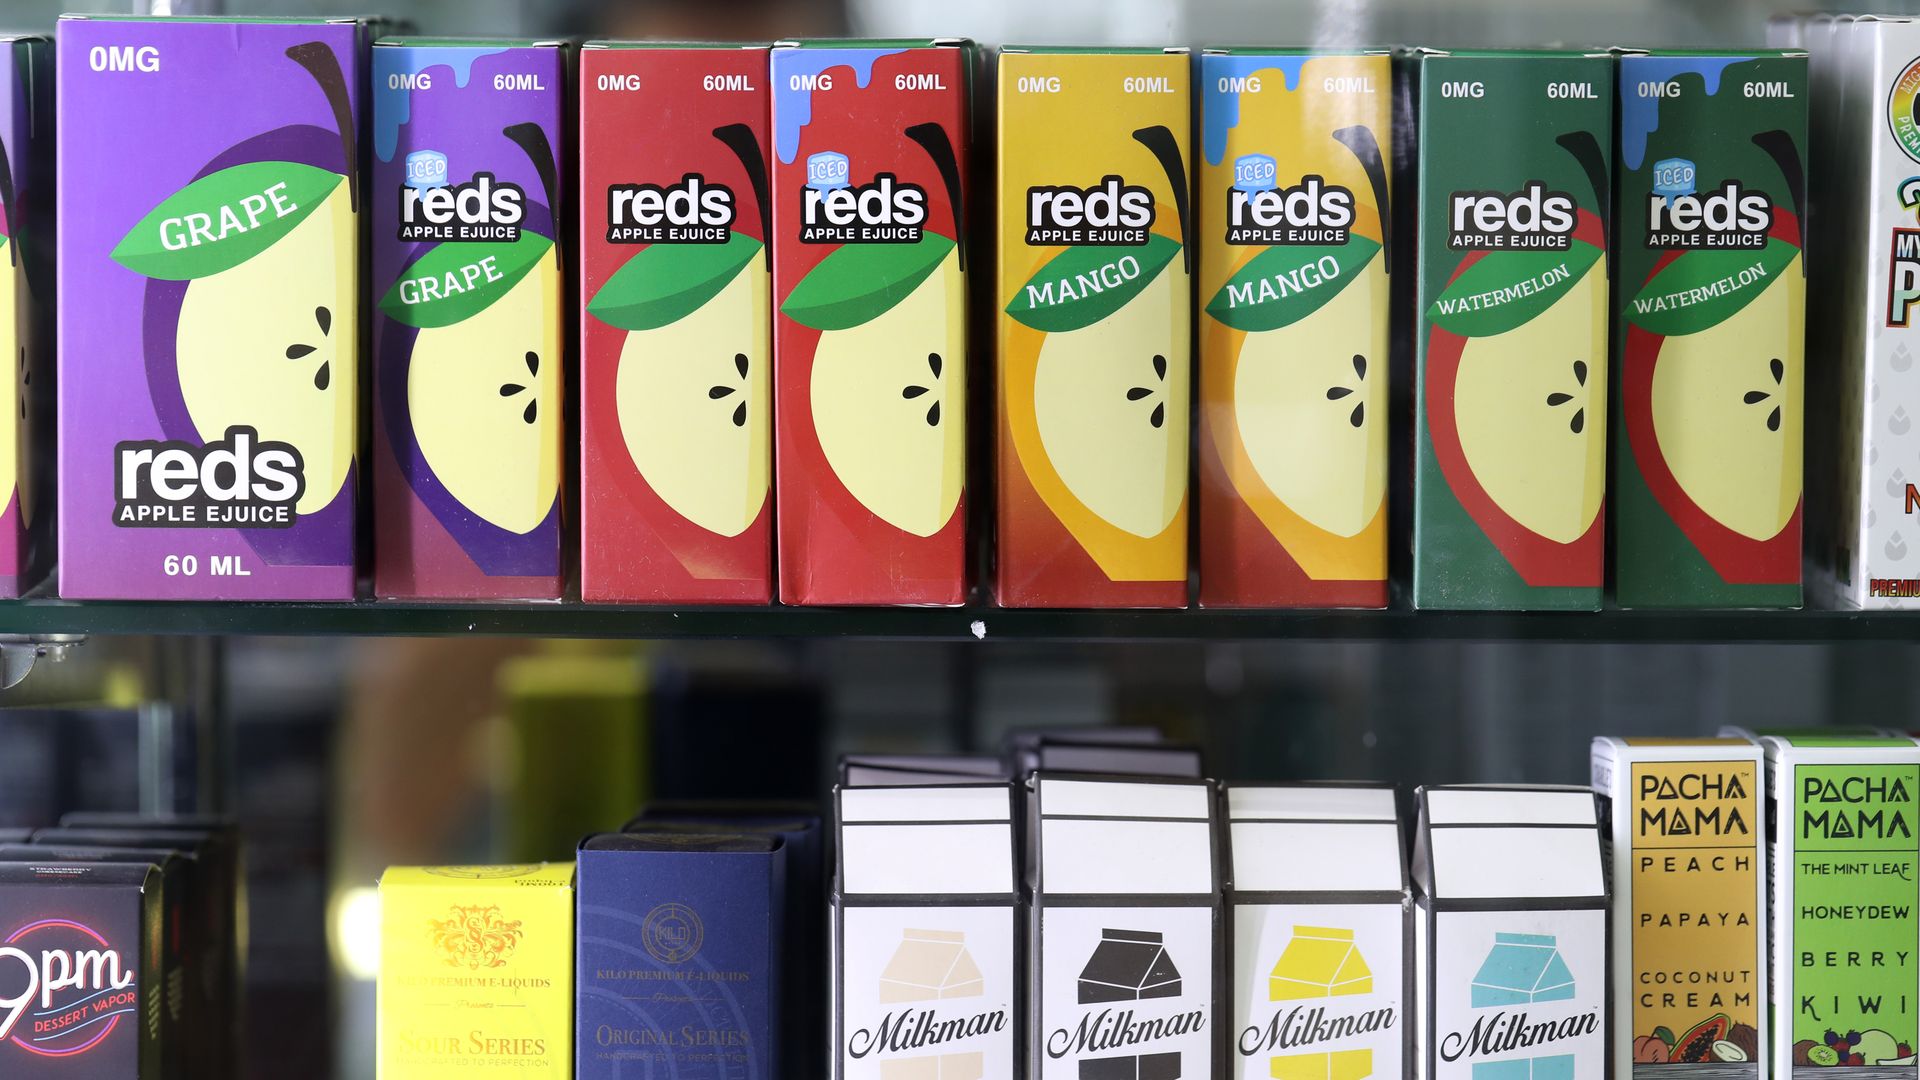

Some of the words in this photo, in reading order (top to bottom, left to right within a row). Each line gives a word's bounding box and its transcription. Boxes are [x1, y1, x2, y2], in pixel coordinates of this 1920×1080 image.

[89, 45, 160, 72] 0MG
[388, 74, 431, 91] 0MG
[493, 74, 545, 91] 60ML
[597, 75, 641, 91] 0MG
[703, 75, 754, 91] 60ML
[789, 74, 832, 91] 0MG
[895, 74, 946, 91] 60ML
[1017, 77, 1061, 93] 0MG
[1123, 77, 1175, 93] 60ML
[1218, 77, 1262, 93] 0MG
[1323, 77, 1375, 94] 60ML
[1441, 82, 1485, 98] 0MG
[1637, 82, 1681, 98] 0MG
[1743, 82, 1794, 98] 60ML
[1900, 66, 1920, 95] MIG
[1547, 82, 1598, 99] 60ML
[407, 159, 445, 179] ICED
[809, 159, 847, 179] ICED
[1236, 162, 1274, 182] ICED
[1655, 167, 1693, 187] ICED
[403, 178, 522, 224] reds
[612, 179, 732, 225] reds
[805, 178, 924, 225] reds
[1031, 181, 1151, 227] reds
[1232, 180, 1351, 227] reds
[1454, 186, 1573, 232] reds
[1650, 184, 1770, 231] reds
[159, 182, 298, 253] GRAPE
[402, 226, 453, 238] APPLE
[460, 226, 516, 239] EJUICE
[611, 228, 662, 240] APPLE
[669, 228, 726, 240] EJUICE
[804, 228, 856, 240] APPLE
[862, 228, 918, 239] EJUICE
[1030, 230, 1082, 242] APPLE
[1088, 230, 1144, 242] EJUICE
[1231, 230, 1282, 241] APPLE
[1288, 230, 1344, 242] EJUICE
[1453, 235, 1504, 247] APPLE
[1510, 235, 1567, 247] EJUICE
[1649, 234, 1700, 246] APPLE
[1707, 234, 1763, 246] EJUICE
[400, 256, 503, 305] GRAPE
[1026, 255, 1141, 309] MANGO
[1226, 255, 1341, 309] MANGO
[1436, 263, 1571, 316] WATERMELON
[1633, 261, 1768, 315] WATERMELON
[121, 433, 298, 502] reds
[120, 505, 196, 522] APPLE
[206, 505, 289, 522] EJUICE
[163, 555, 198, 576] 60
[210, 556, 251, 576] ML
[1641, 807, 1748, 836] MAMA
[1803, 810, 1911, 838] MAMA
[1641, 857, 1749, 872] PEACH
[1802, 863, 1830, 875] THE
[1834, 863, 1869, 875] MINT
[1873, 863, 1912, 881] LEAF
[1641, 913, 1749, 927] PAPAYA
[1802, 905, 1909, 919] HONEYDEW
[1802, 952, 1909, 967] BERRY
[432, 977, 486, 987] PREMIUM
[490, 977, 551, 989] E-LIQUIDS
[596, 969, 627, 980] KILO
[629, 969, 685, 980] PREMIUM
[688, 970, 750, 982] E-LIQUIDS
[1640, 971, 1750, 984] COCONUT
[0, 947, 132, 1039] 9pm
[1641, 993, 1750, 1008] CREAM
[34, 1006, 88, 1032] DESSERT
[92, 992, 135, 1013] VAPOR
[1802, 996, 1906, 1021] KIWI
[596, 1025, 676, 1047] ORIGINAL
[680, 1025, 749, 1048] SERIES
[849, 1009, 1008, 1059] Milkman
[1047, 1009, 1206, 1059] Milkman
[1238, 1005, 1397, 1056] Milkman
[1440, 1011, 1599, 1062] Milkman
[468, 1030, 545, 1055] SERIES
[473, 1058, 485, 1066] TO
[488, 1058, 549, 1067] PERFECTION
